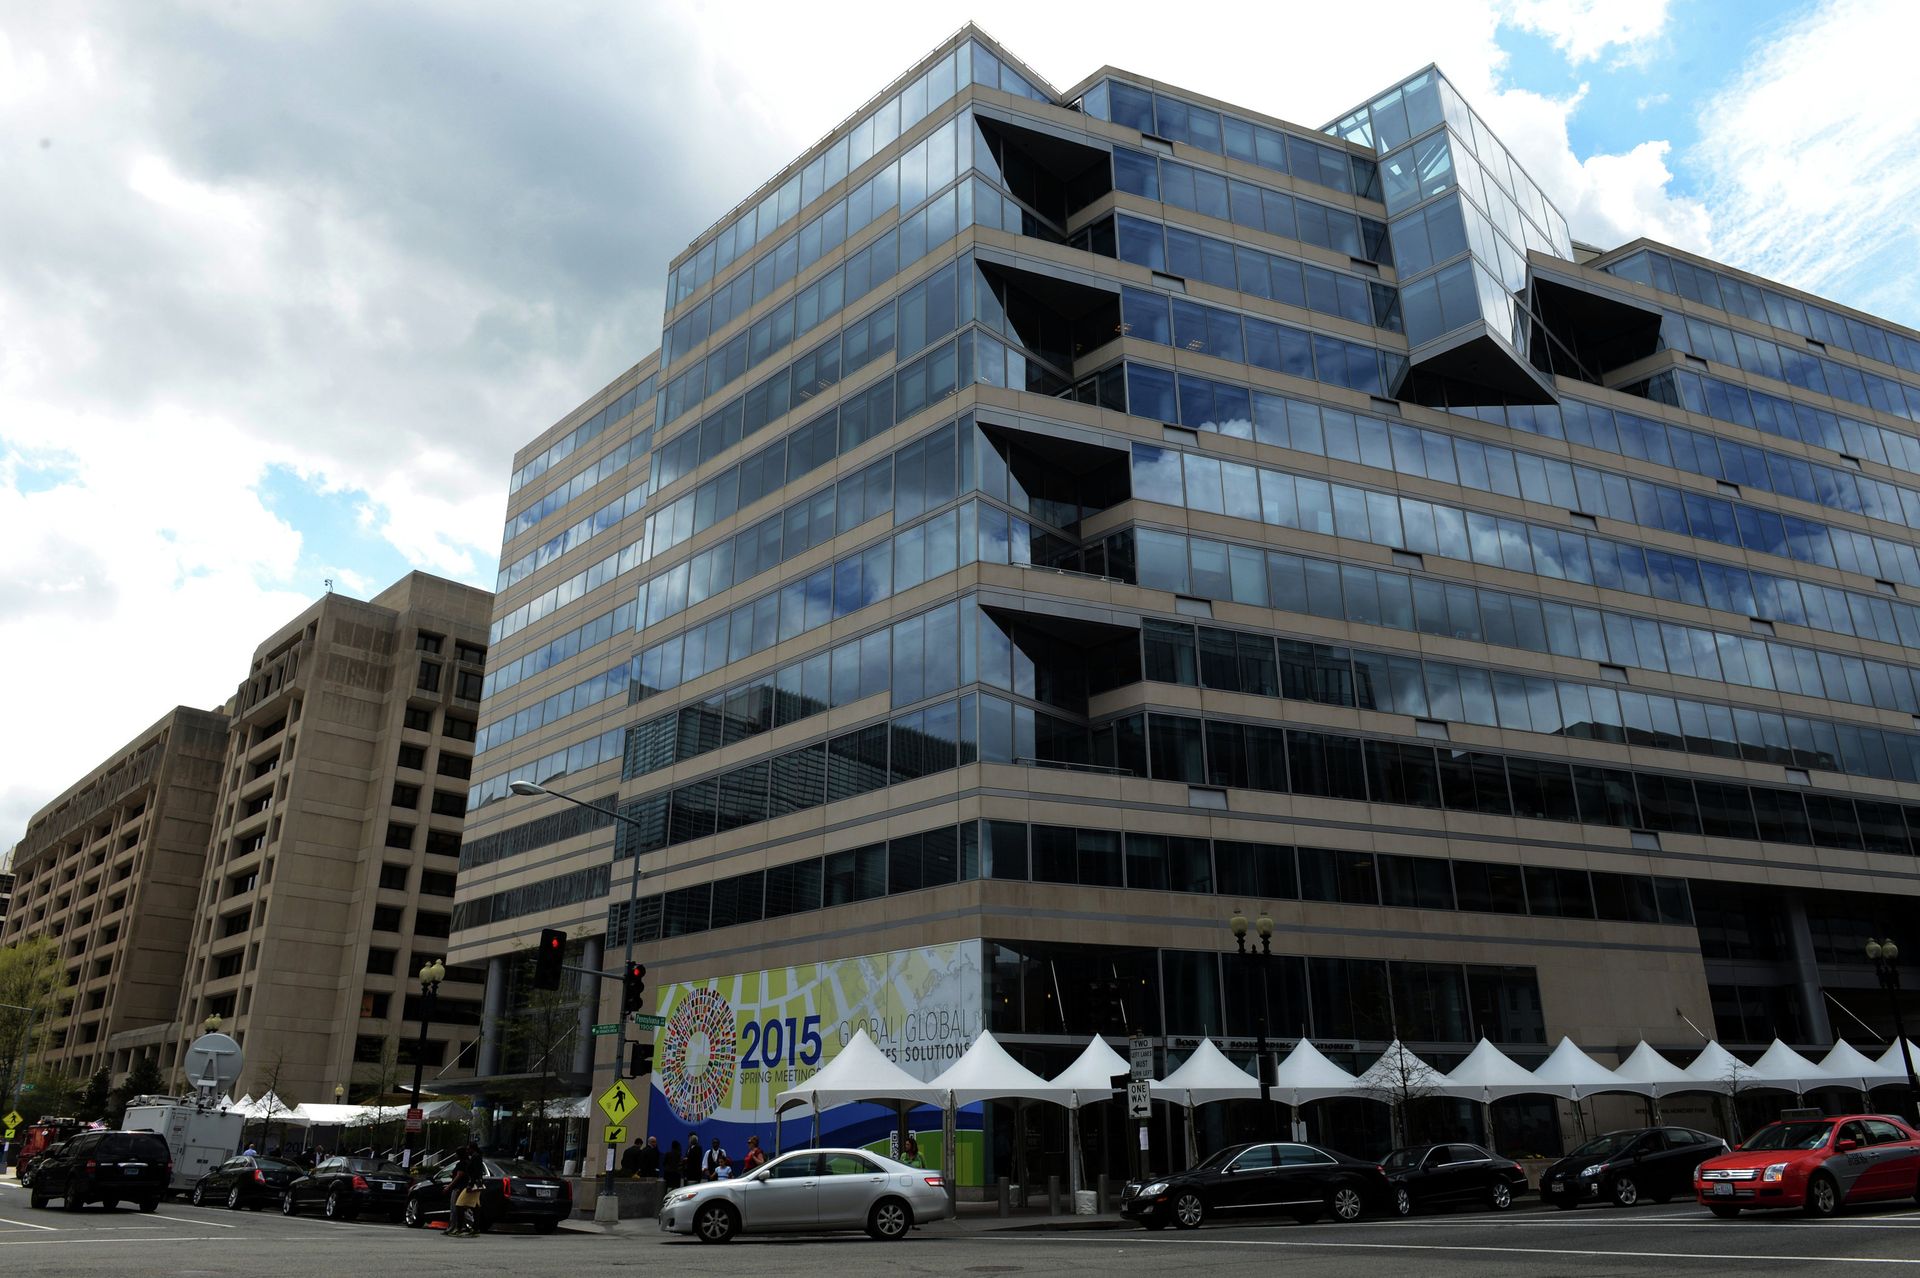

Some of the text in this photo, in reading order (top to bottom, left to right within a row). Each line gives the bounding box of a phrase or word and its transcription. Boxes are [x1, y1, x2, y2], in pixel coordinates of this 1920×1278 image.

[905, 1009, 970, 1042] GLOBAL
[740, 1015, 822, 1069] 2015
[905, 1042, 970, 1062] SOLUTIONS
[1135, 1060, 1148, 1068] MUST
[740, 1068, 822, 1085] SPRING MEETING
[1131, 1084, 1146, 1094] ONE
[1131, 1094, 1147, 1103] WAY
